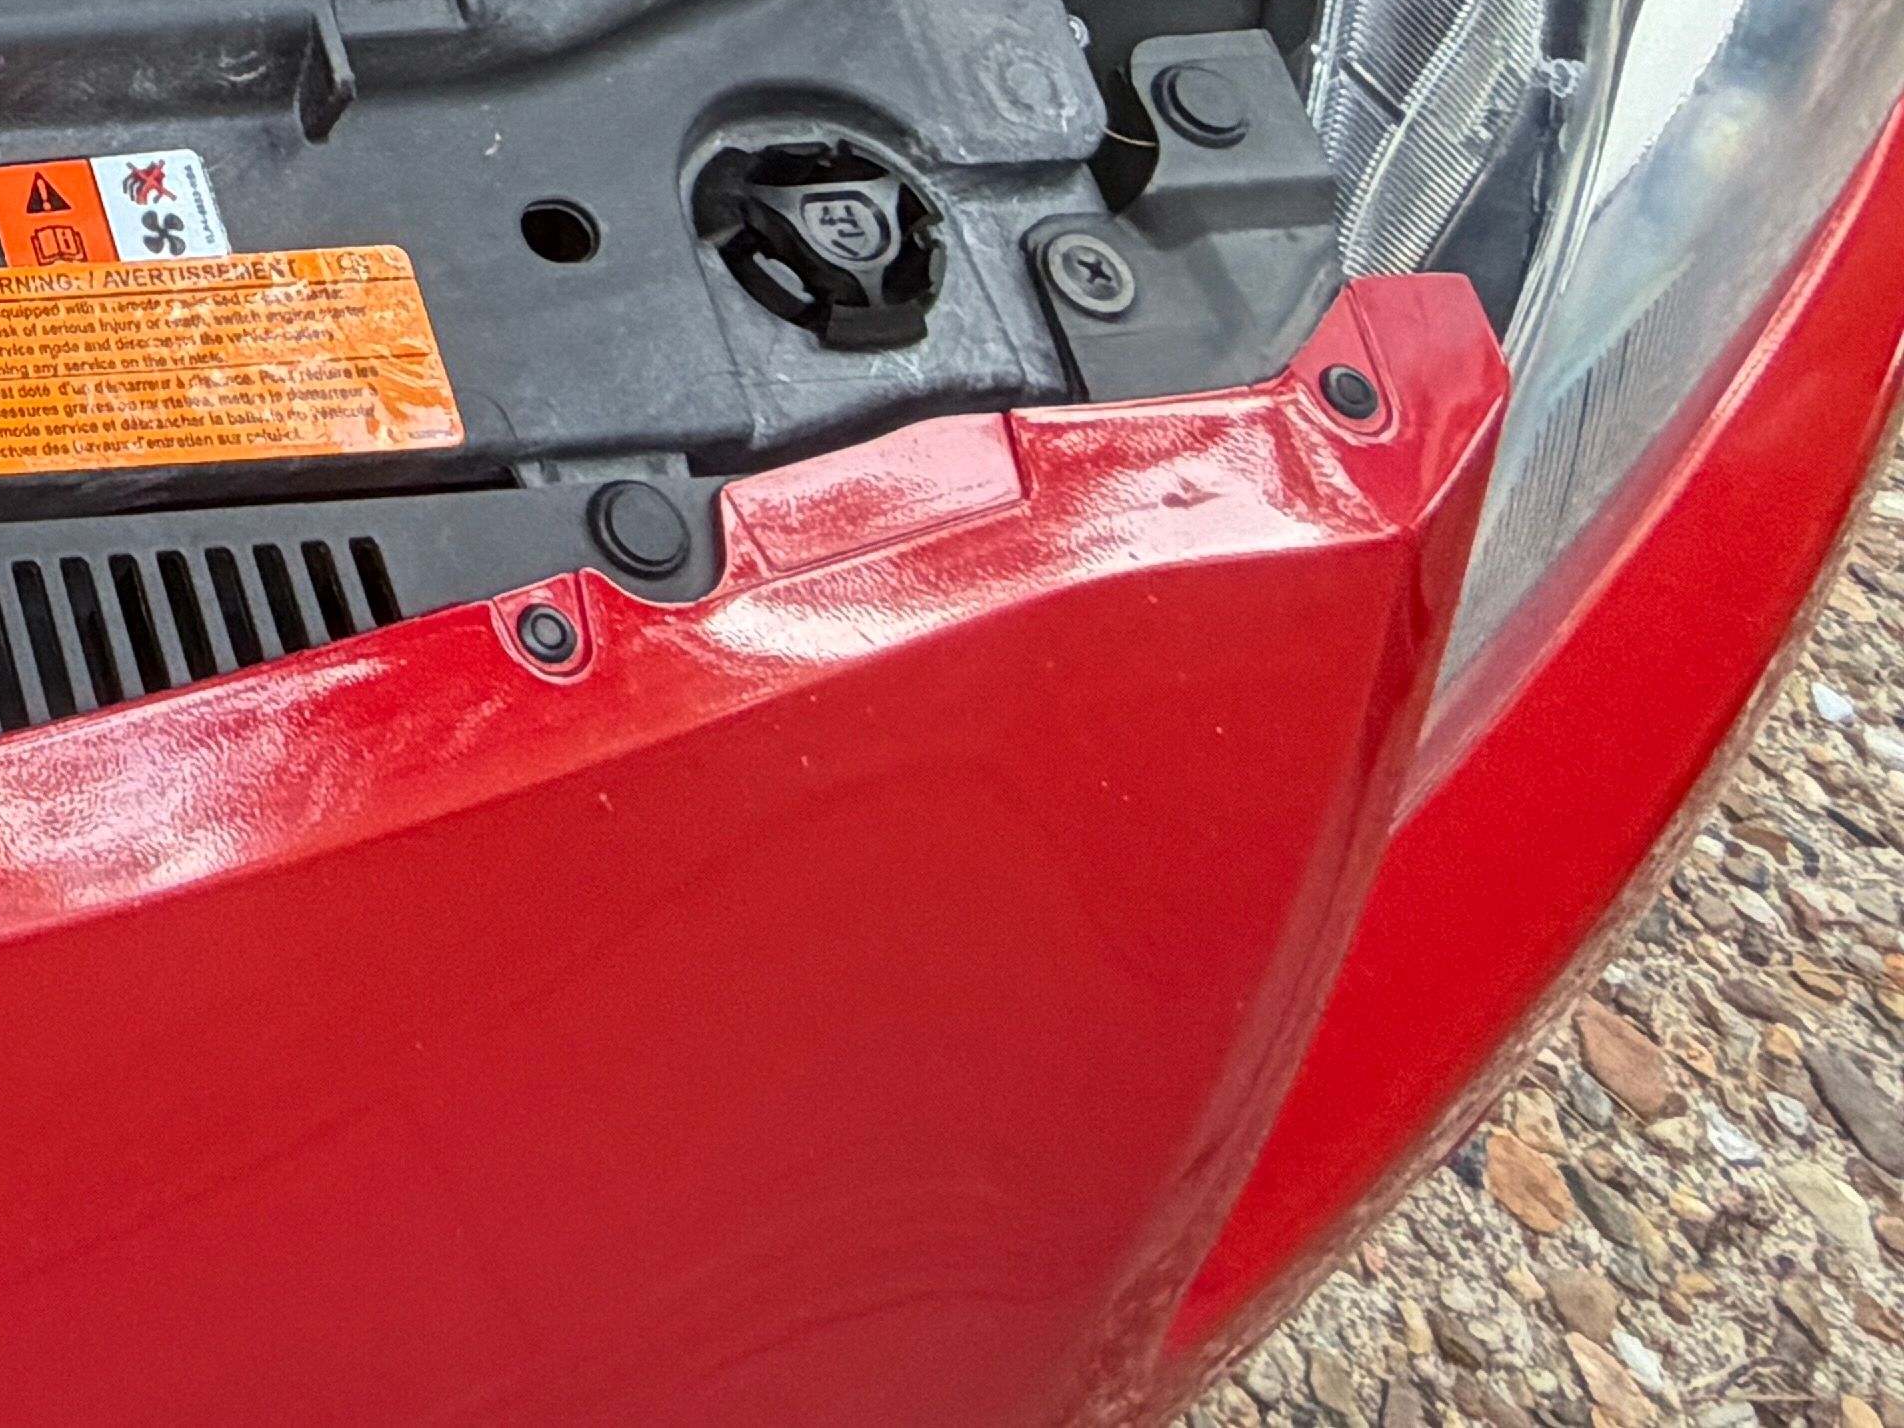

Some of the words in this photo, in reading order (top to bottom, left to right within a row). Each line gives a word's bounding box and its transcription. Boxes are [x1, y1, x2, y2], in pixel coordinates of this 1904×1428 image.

[22, 322, 36, 337] of
[41, 319, 95, 336] serious
[99, 316, 141, 332] injury
[145, 315, 161, 329] or
[83, 338, 111, 354] and
[32, 359, 58, 375] any
[63, 355, 116, 373] service
[120, 354, 138, 370] on
[142, 352, 167, 368] the
[44, 419, 98, 435] service
[102, 418, 116, 431] et
[42, 441, 68, 455] des
